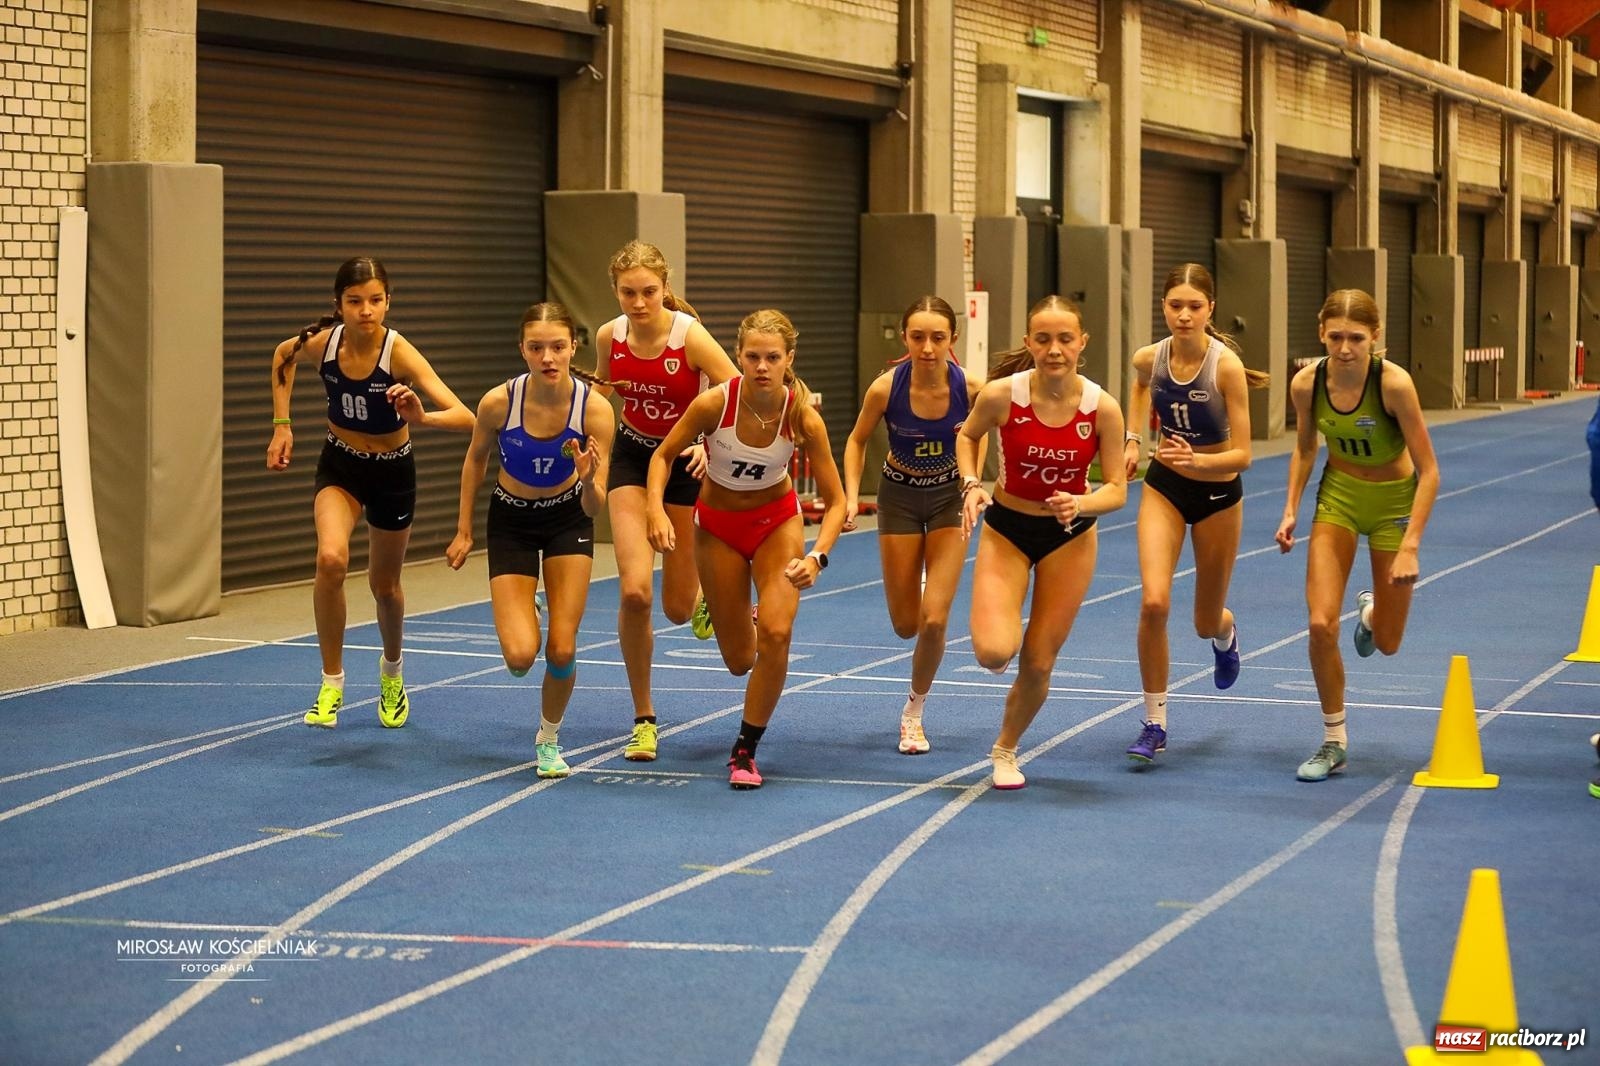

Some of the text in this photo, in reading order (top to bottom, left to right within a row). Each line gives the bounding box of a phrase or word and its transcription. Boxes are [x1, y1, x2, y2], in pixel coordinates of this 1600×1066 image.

[341, 393, 368, 421] 96
[624, 396, 679, 420] 762
[1170, 402, 1191, 430] 11
[624, 428, 658, 448] PRO
[1336, 437, 1372, 457] 111
[334, 439, 371, 460] PRO
[915, 440, 943, 458] 20
[1027, 445, 1078, 461] PIAST
[532, 457, 555, 474] 17
[731, 460, 767, 481] 74
[908, 472, 950, 487] NIKE
[494, 486, 573, 509] PRO NIKE
